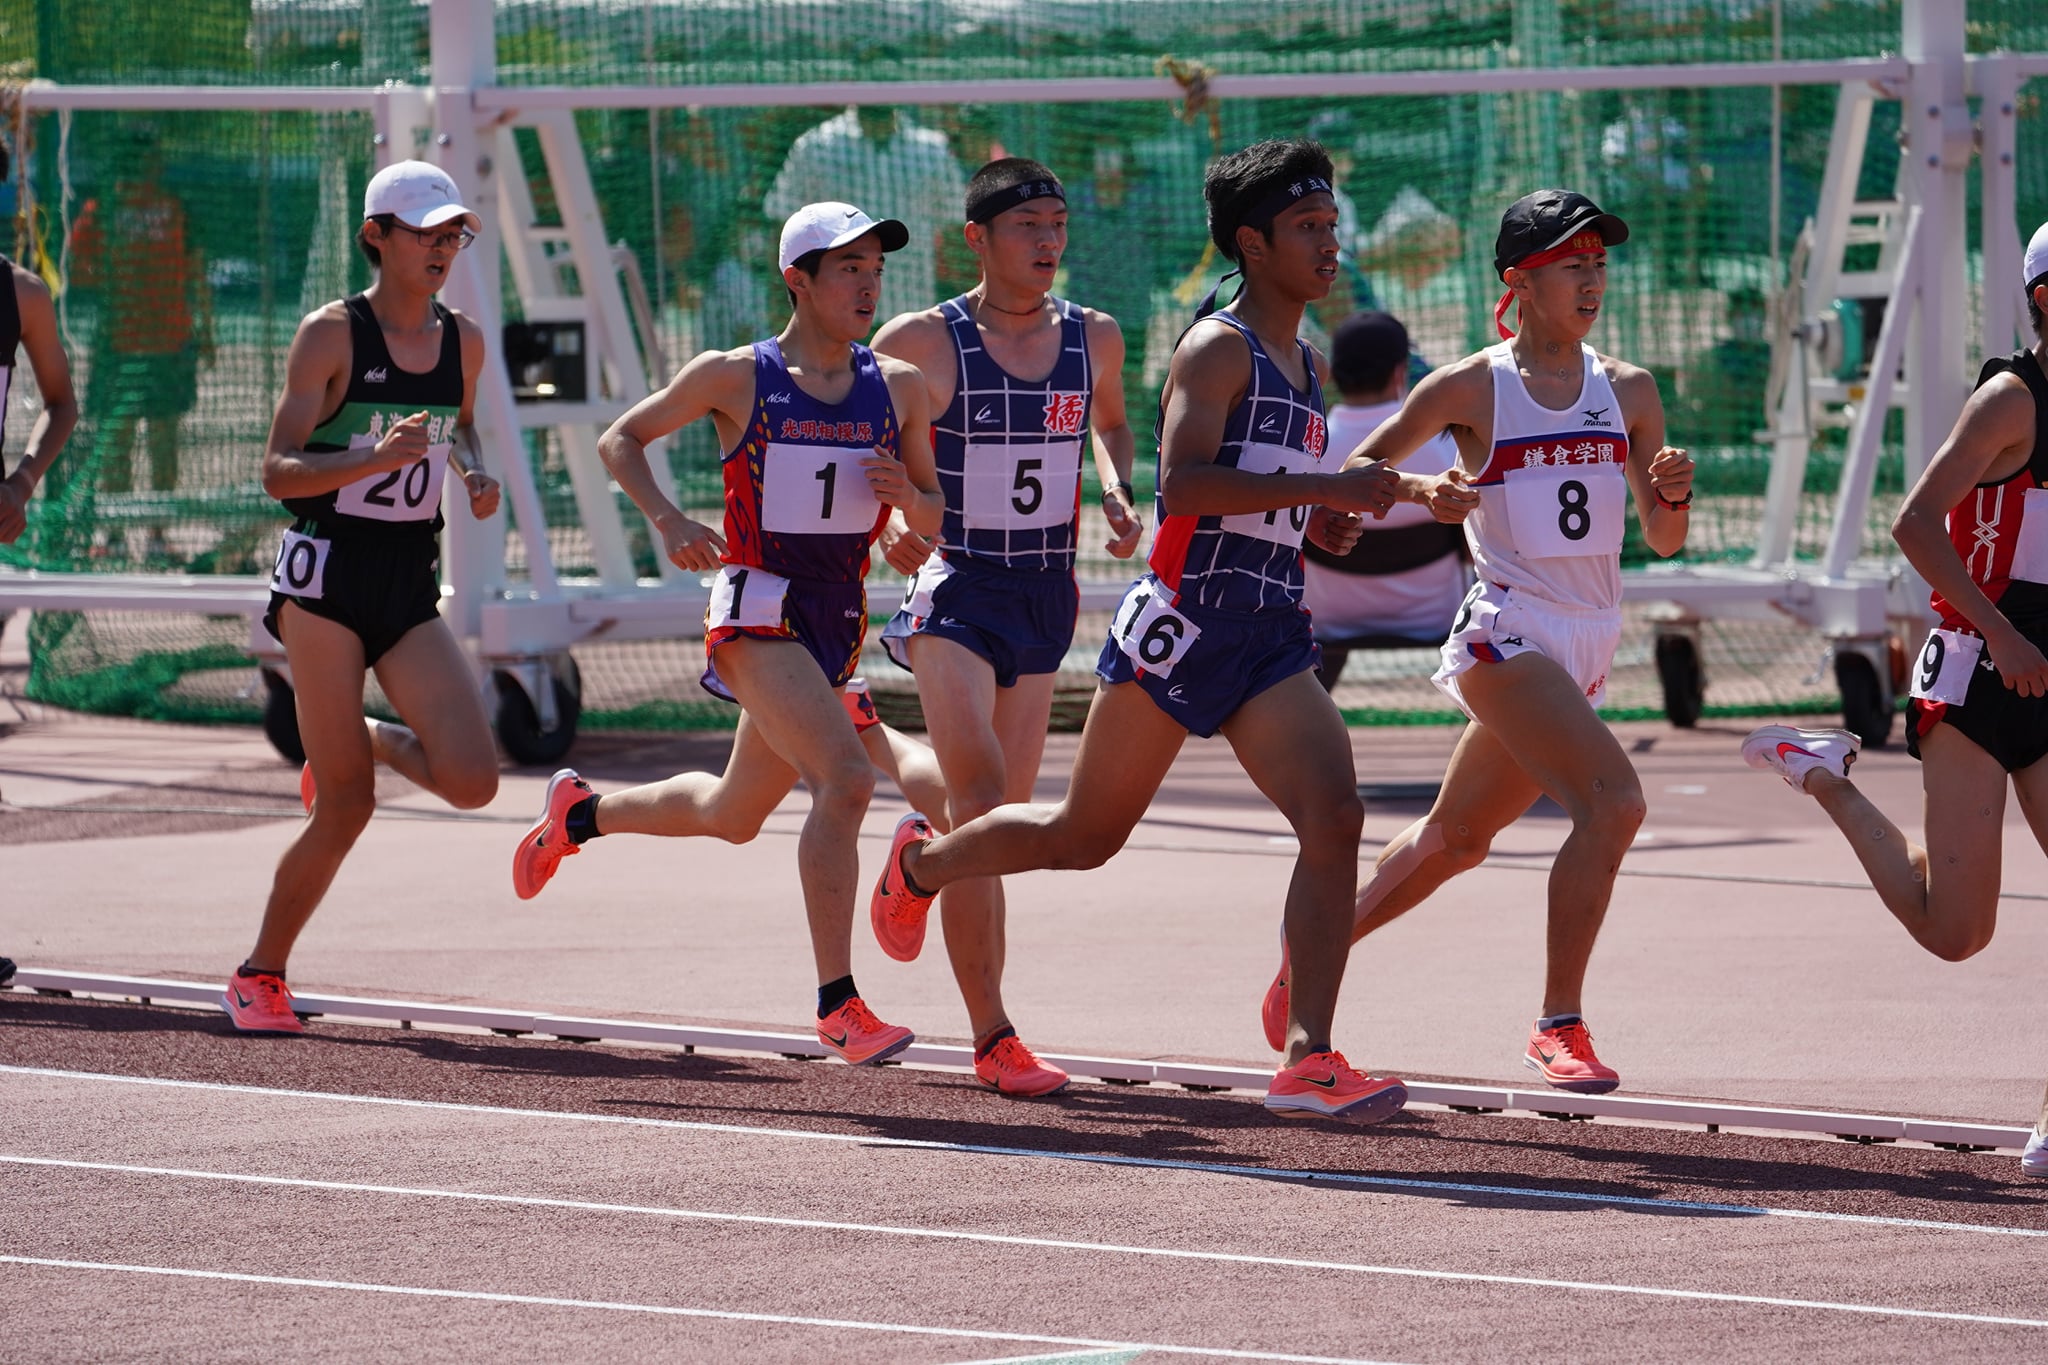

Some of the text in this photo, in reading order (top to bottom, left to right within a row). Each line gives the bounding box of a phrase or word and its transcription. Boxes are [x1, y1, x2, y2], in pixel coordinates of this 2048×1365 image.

[366, 411, 456, 445] 東相模
[781, 418, 874, 442] 光明相模原
[1042, 392, 1084, 435] 橘
[1522, 442, 1615, 467] 鎌倉学園
[364, 458, 430, 508] 20
[815, 462, 837, 519] 1
[1011, 459, 1042, 515] 5
[1558, 480, 1591, 540] 8
[728, 569, 750, 620] 1
[1121, 593, 1184, 665] 16
[1920, 634, 1945, 692] 9
